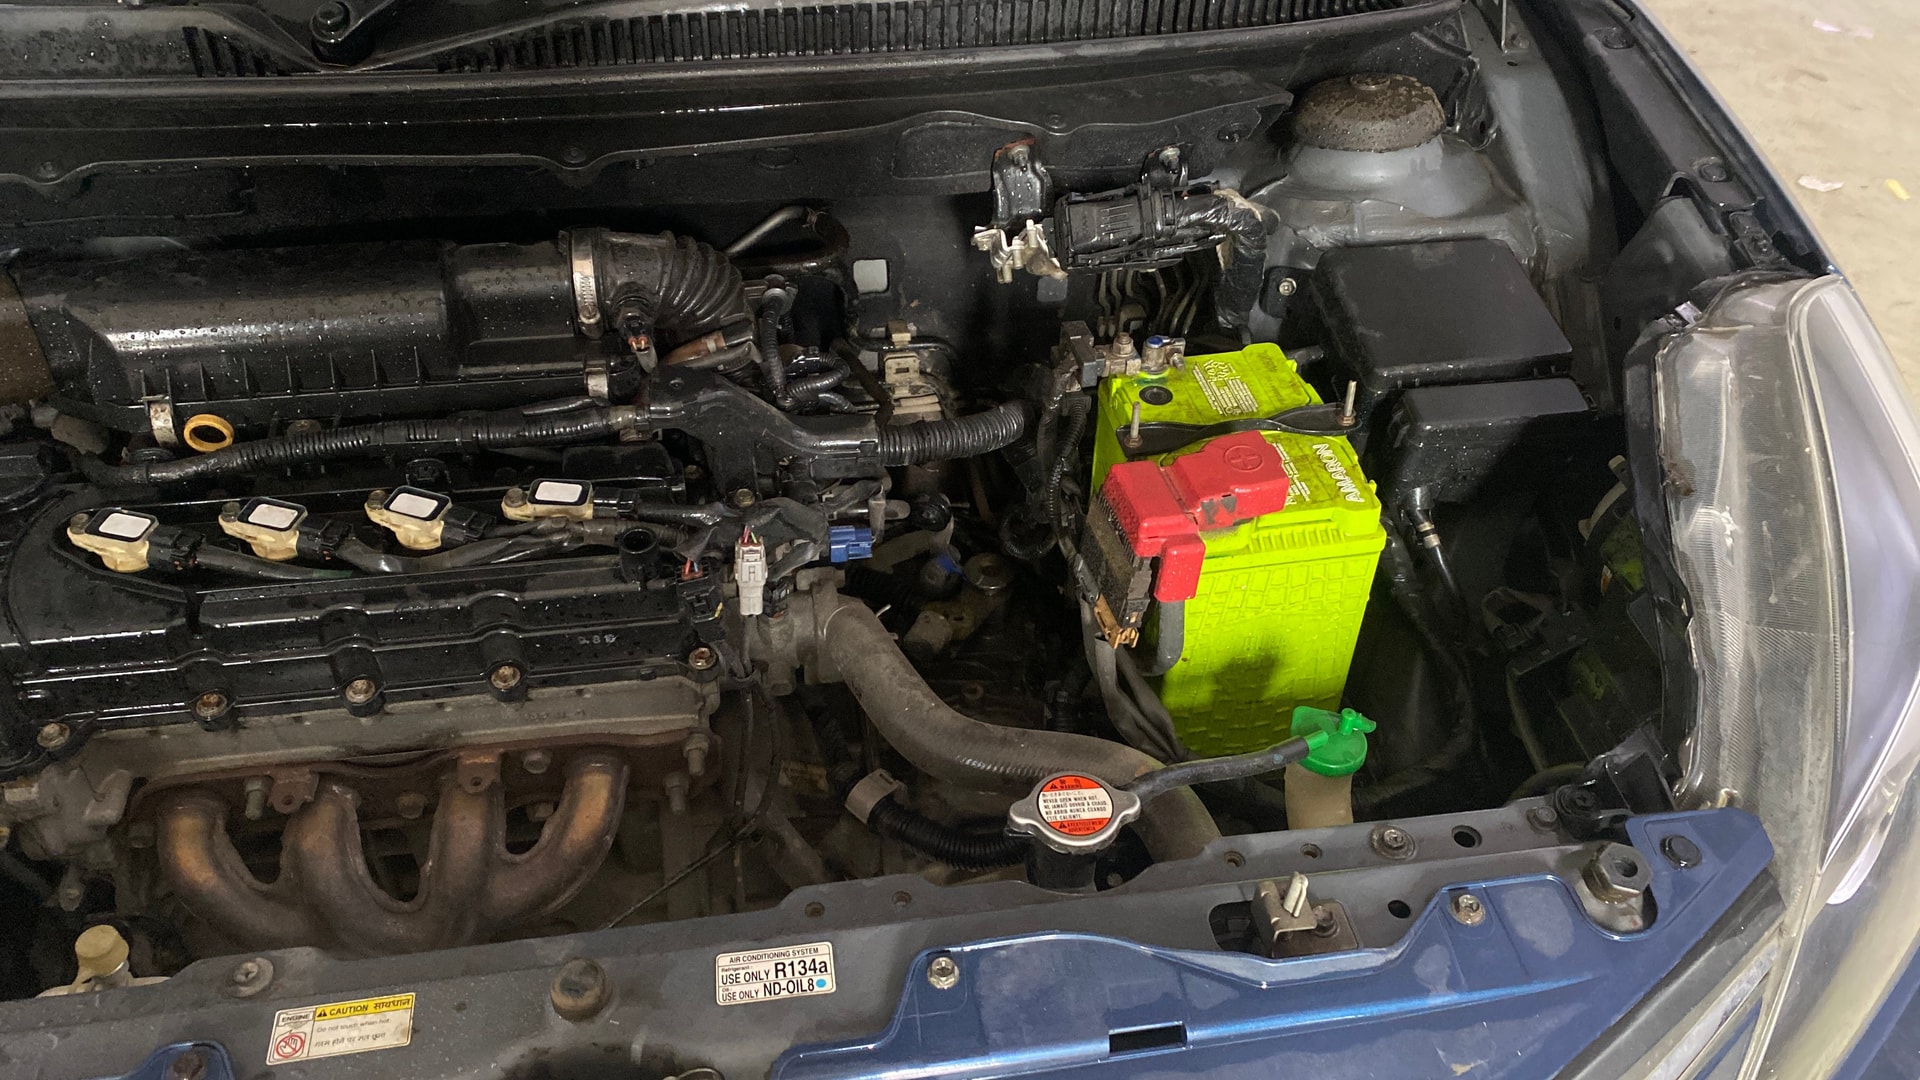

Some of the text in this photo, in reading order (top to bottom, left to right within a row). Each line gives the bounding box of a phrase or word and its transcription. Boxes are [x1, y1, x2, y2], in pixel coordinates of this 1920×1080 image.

[1312, 443, 1365, 503] AMARON
[730, 947, 819, 964] AIR CONDITIONING SYSTEM
[721, 958, 828, 985] USE ONLY R134a
[722, 978, 815, 1002] USE ONLY ND-OIL8
[329, 1004, 369, 1017] CAUTION
[373, 998, 411, 1011] सावधान
[282, 1013, 310, 1023] ENGINE
